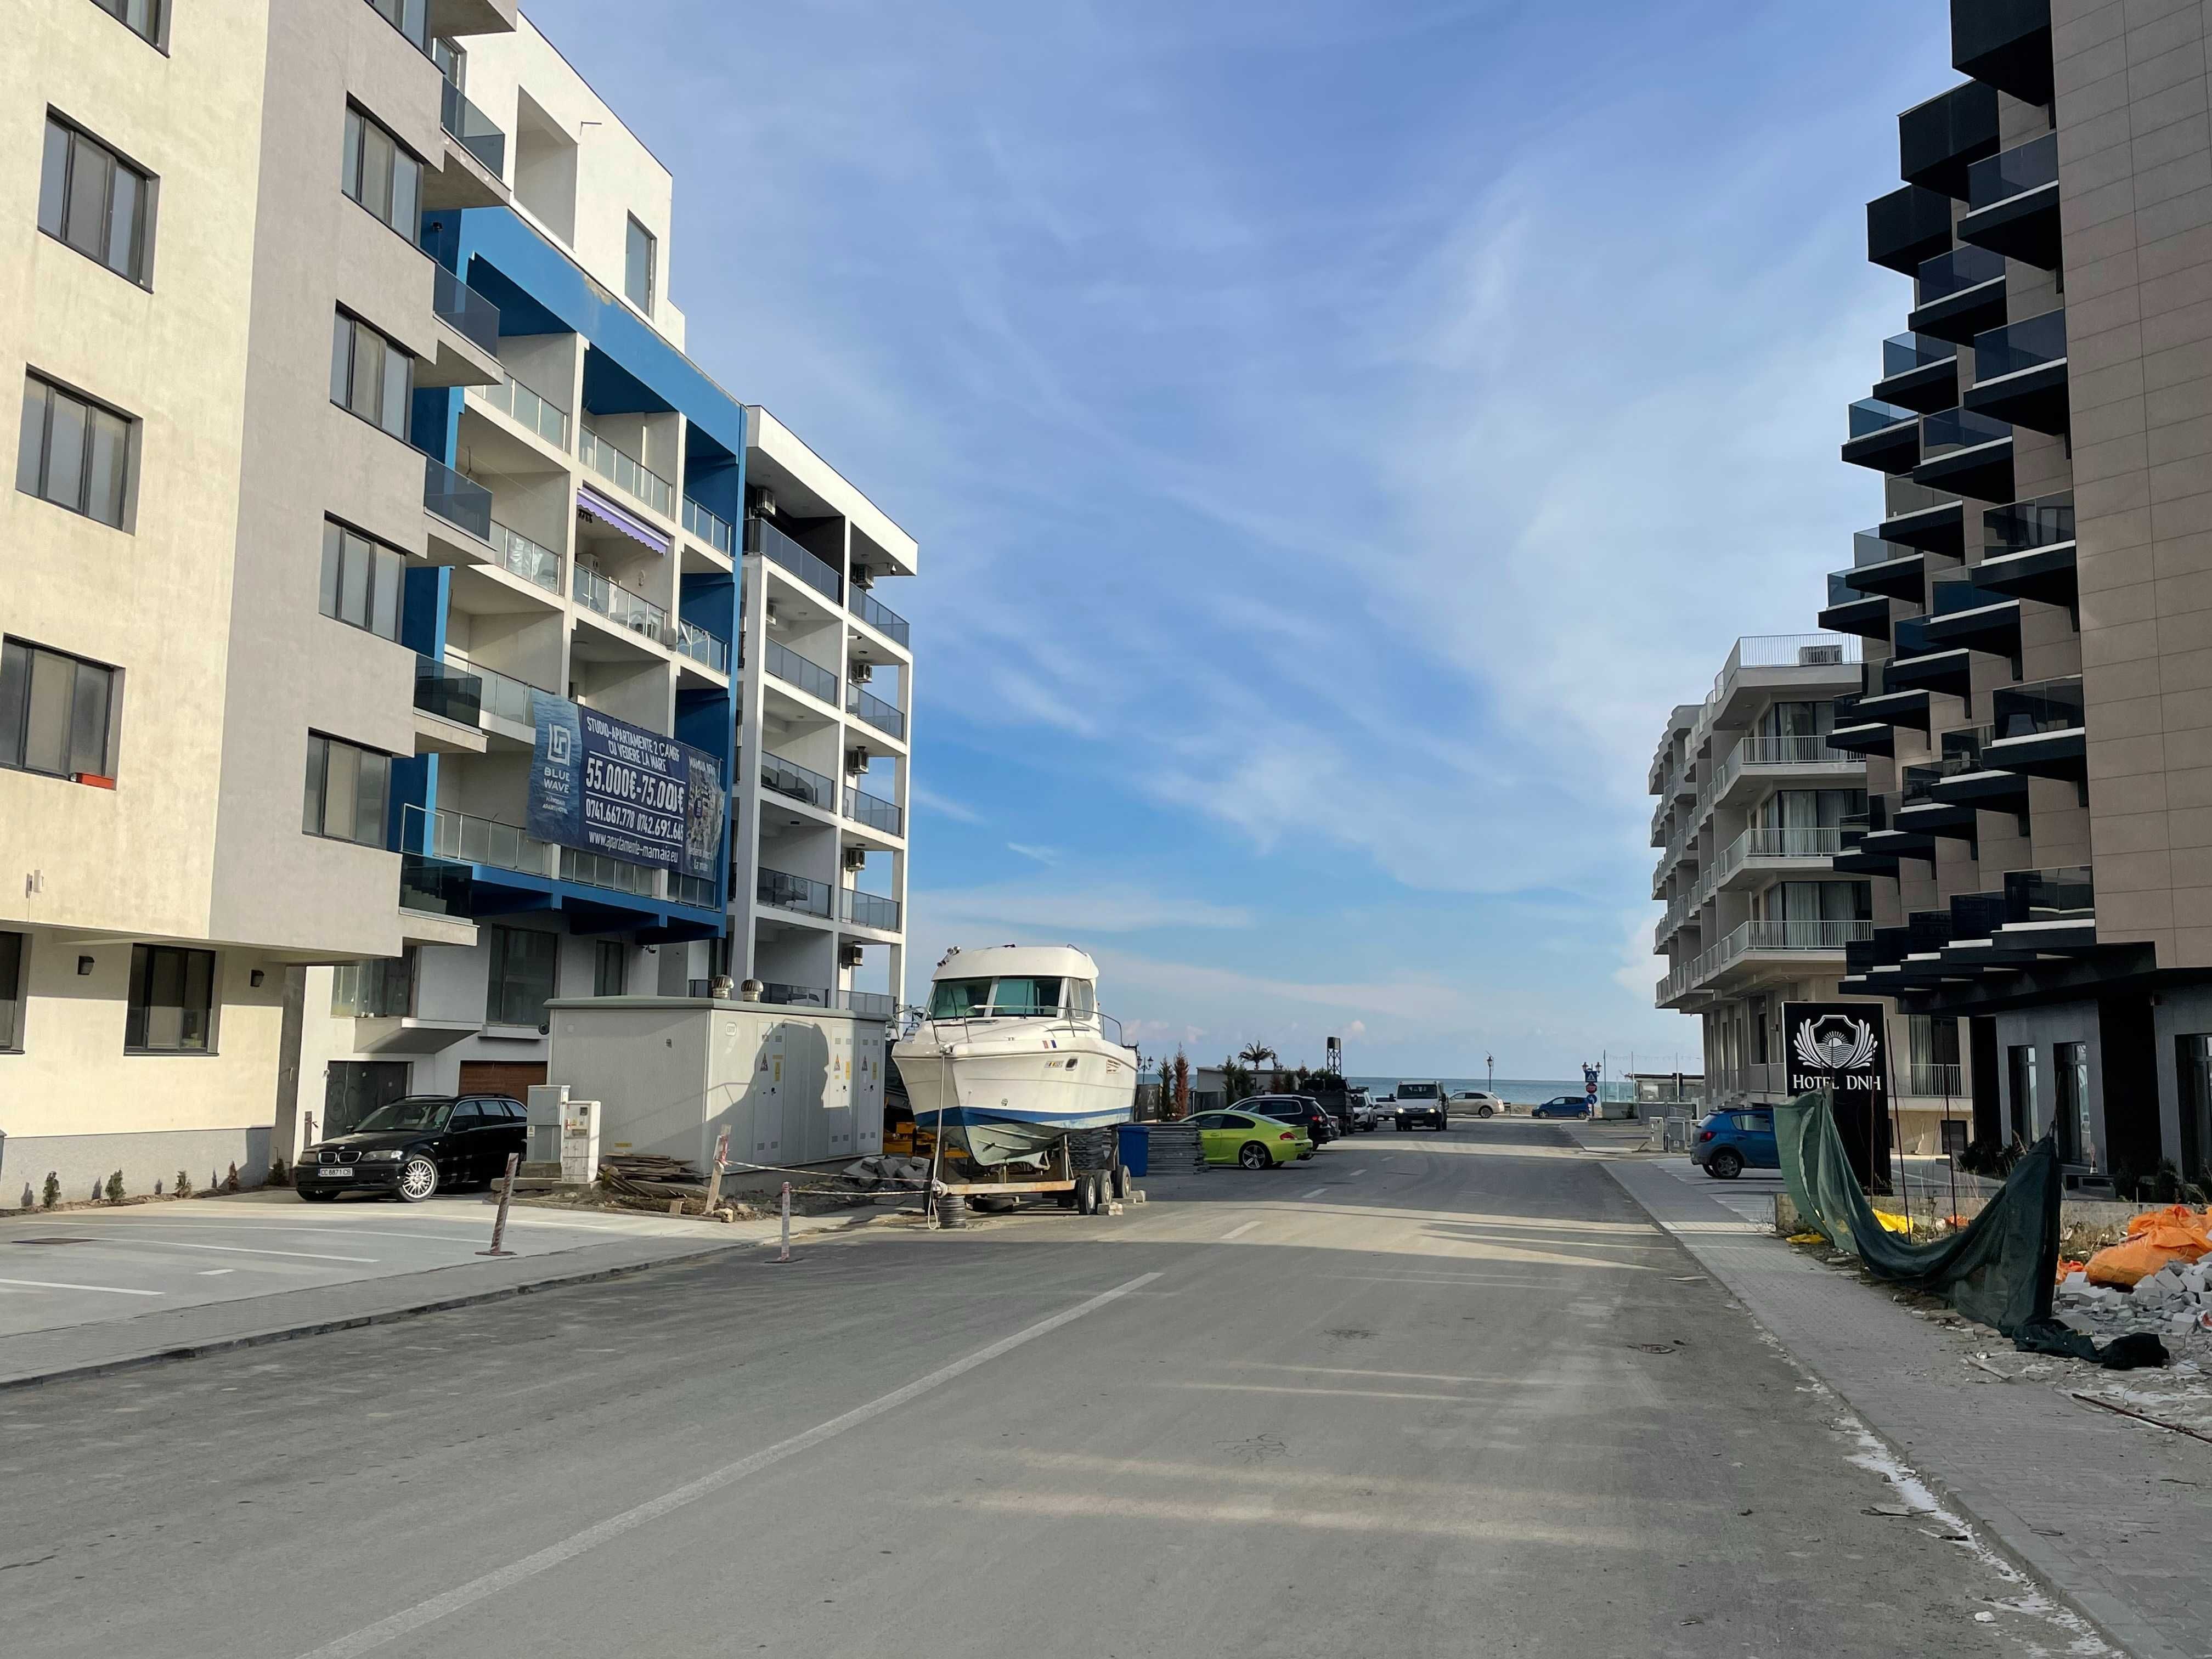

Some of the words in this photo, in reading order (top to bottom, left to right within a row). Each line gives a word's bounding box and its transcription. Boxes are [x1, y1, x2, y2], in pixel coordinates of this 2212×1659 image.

[608, 740, 617, 756] CU
[641, 751, 650, 768] LA
[544, 767, 570, 782] BLUE
[544, 778, 569, 794] WAVE
[586, 798, 635, 828] 0741.667.778
[1793, 1074, 1839, 1090] HOTEL
[1846, 1075, 1881, 1091] DNH
